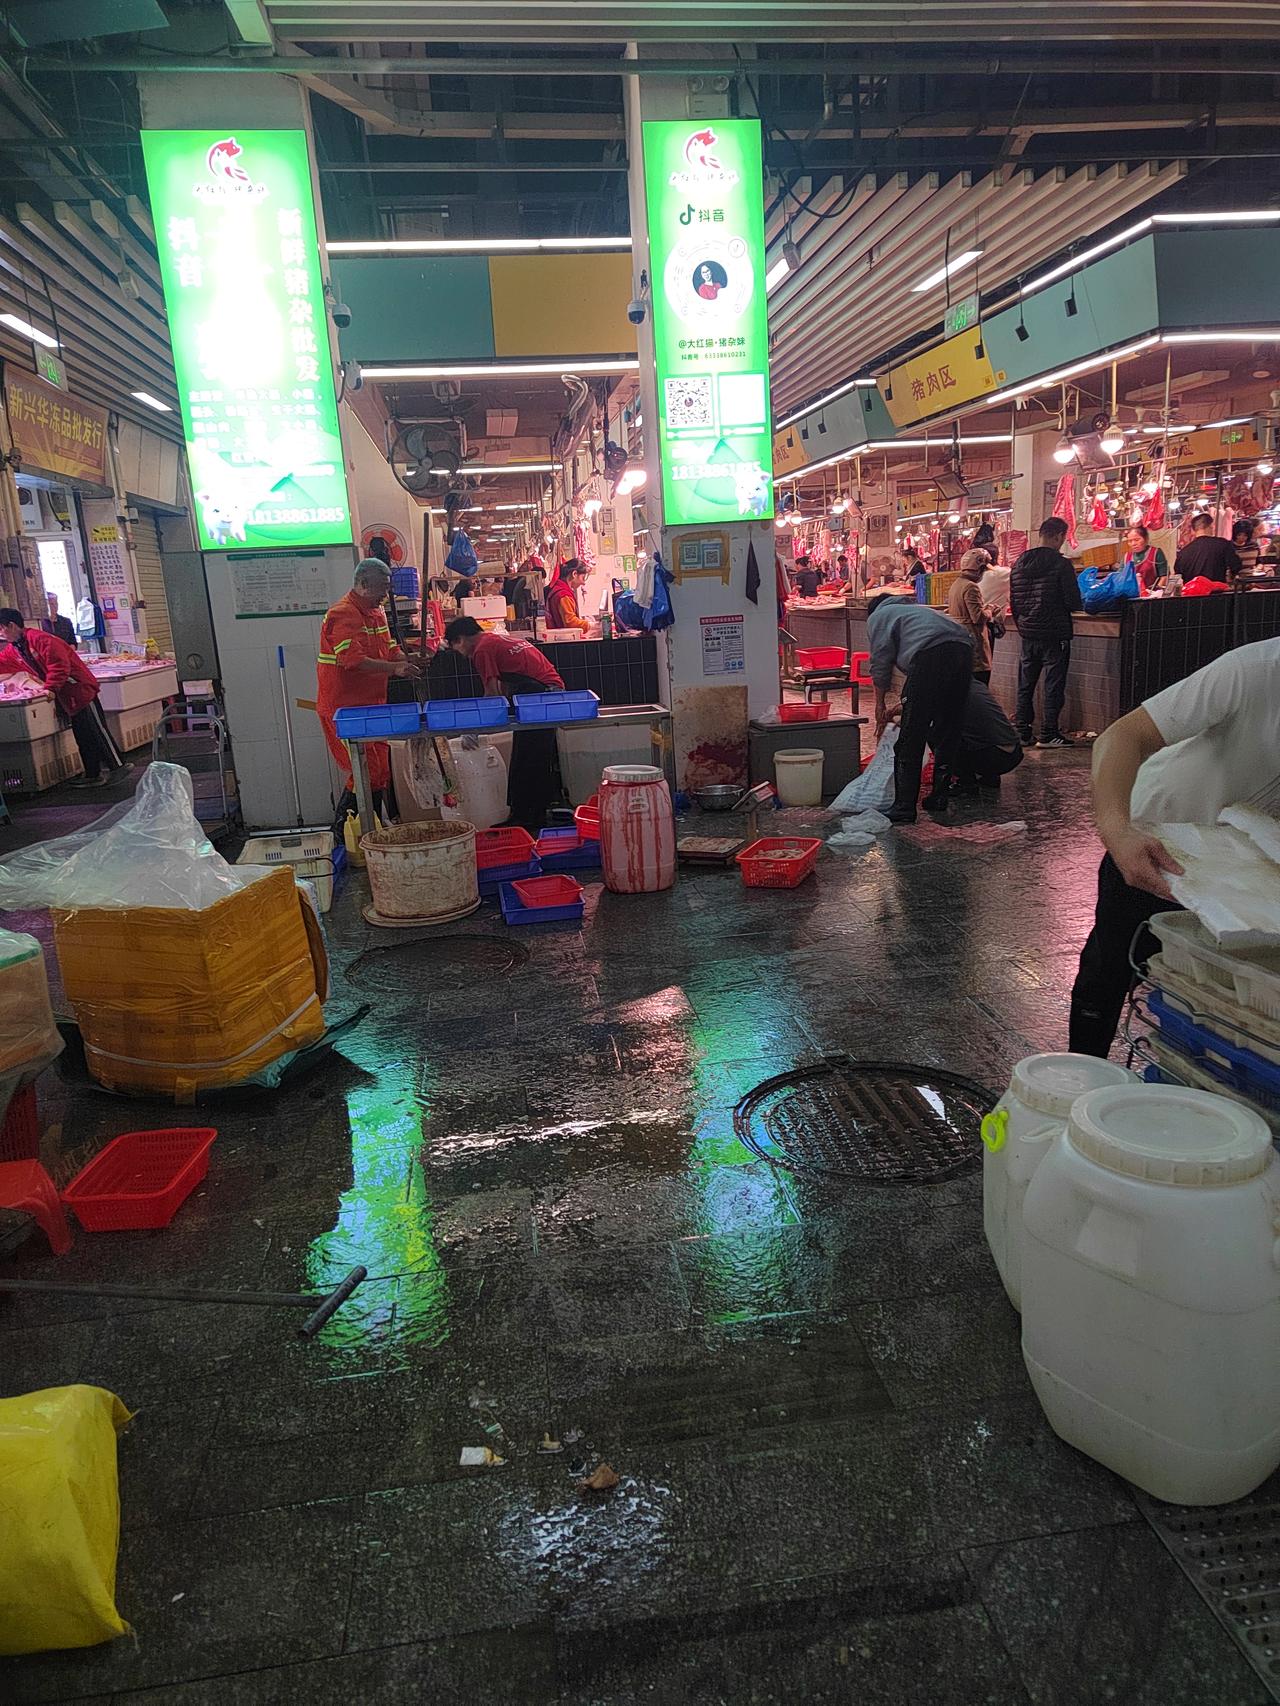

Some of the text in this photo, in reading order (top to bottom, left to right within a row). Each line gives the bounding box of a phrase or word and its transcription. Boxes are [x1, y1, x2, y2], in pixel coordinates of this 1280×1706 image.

[699, 208, 725, 223] 抖音
[277, 207, 321, 382] 新鲜猪杂批发
[910, 364, 957, 401] 猪肉区
[10, 383, 103, 450] 新兴华冻品批发行
